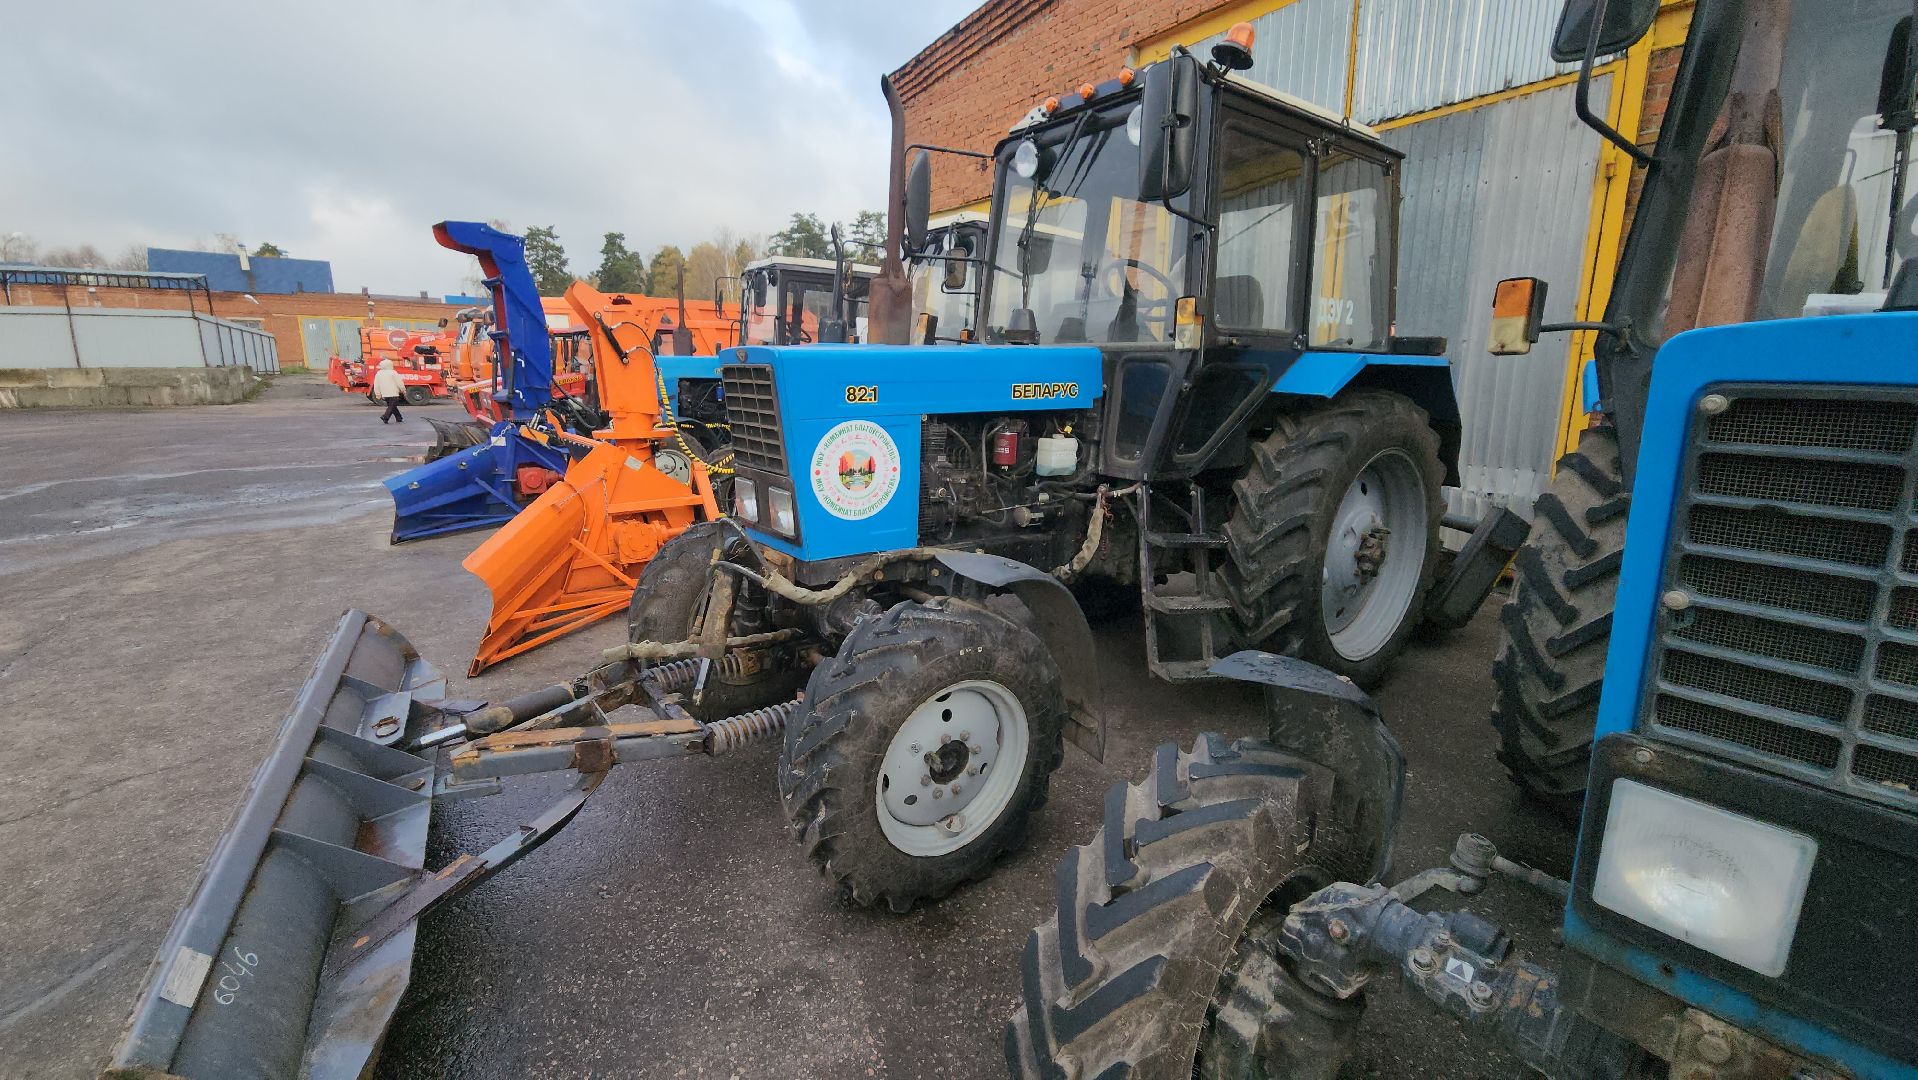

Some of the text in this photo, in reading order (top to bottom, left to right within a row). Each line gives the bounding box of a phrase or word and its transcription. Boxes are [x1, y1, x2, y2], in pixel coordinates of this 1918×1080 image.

[1346, 300, 1354, 325] 2
[845, 386, 878, 403] 82.1
[1011, 383, 1079, 400] БЕЛАРУС
[214, 946, 259, 1005] 6046
